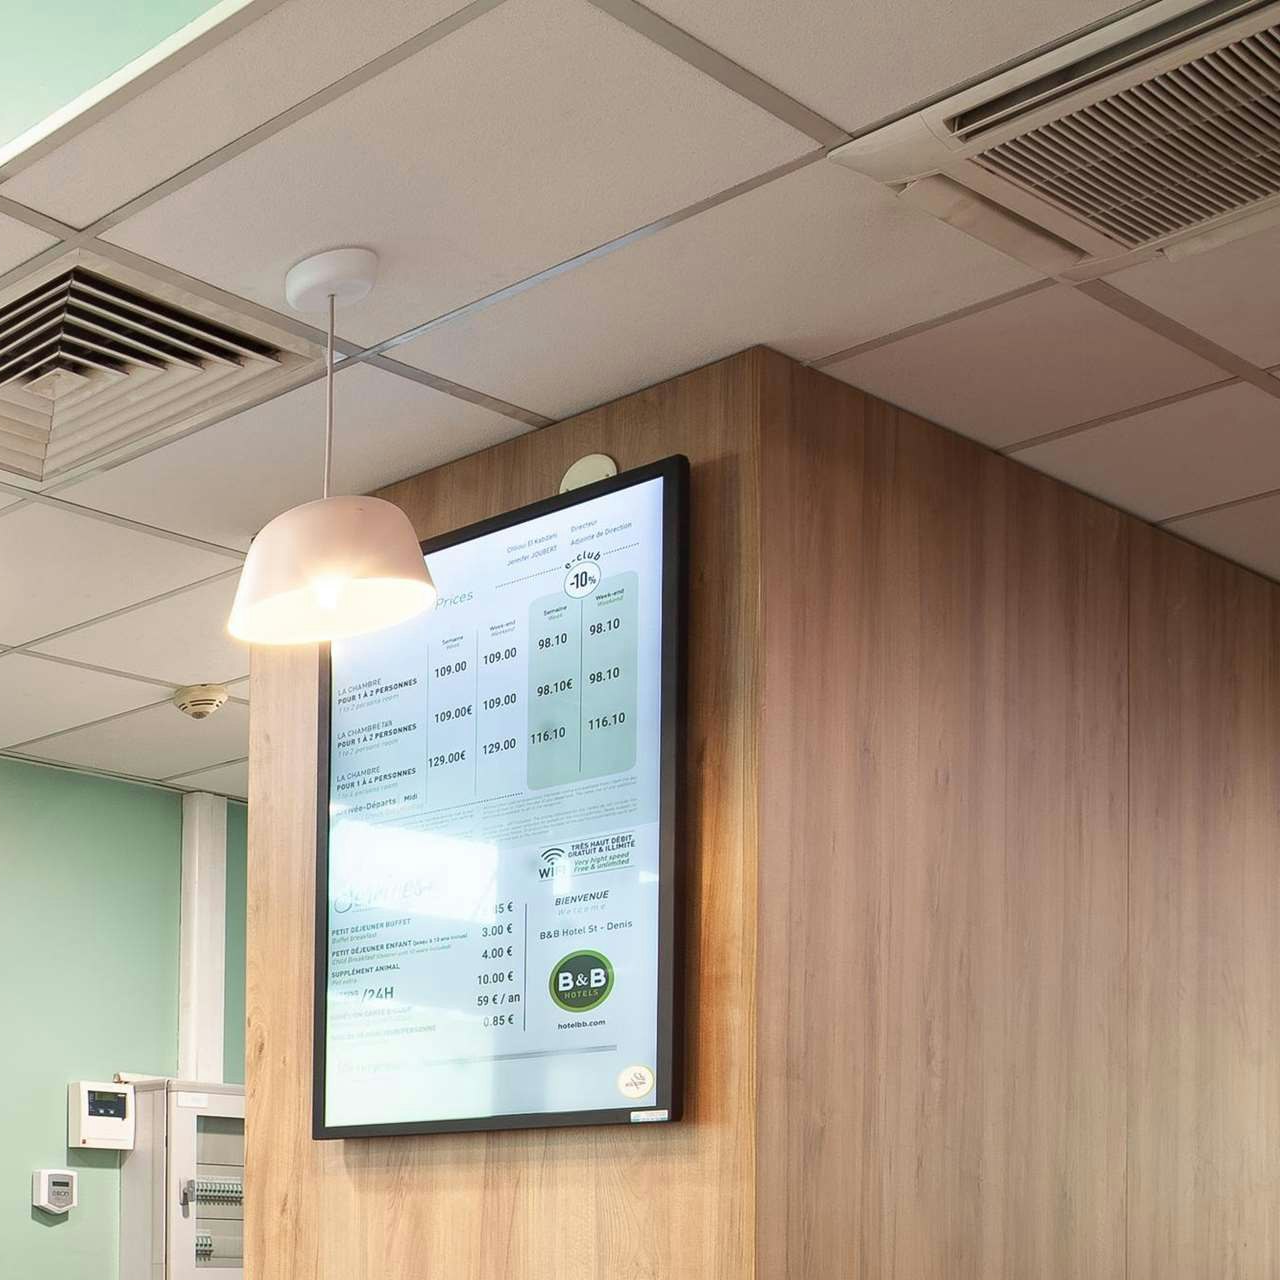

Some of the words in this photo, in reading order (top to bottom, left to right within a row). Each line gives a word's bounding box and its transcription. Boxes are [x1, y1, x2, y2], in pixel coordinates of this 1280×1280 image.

[565, 550, 601, 570] e-club
[589, 618, 620, 636] 98.10
[538, 633, 567, 650] 98.10
[483, 647, 517, 664] 109.00
[435, 661, 467, 678] 109.00
[589, 667, 620, 684] 98.10
[337, 694, 355, 704] POUR
[375, 677, 416, 695] PERSONNES
[537, 678, 573, 697] 98.10€
[483, 693, 517, 711] 109.00
[434, 704, 472, 723] 109.00€
[588, 712, 626, 731] 116.10
[337, 738, 354, 748] POUR
[375, 722, 416, 739] PERSONNES
[530, 727, 566, 744] 116.10
[483, 738, 517, 756] 129.00
[428, 750, 466, 768] 129.00€
[336, 781, 354, 791] POUR
[374, 766, 415, 783] PERSONNES
[590, 838, 609, 847] HAUT
[555, 889, 609, 906] BIENVENUE
[332, 927, 348, 936] PETIT
[482, 924, 504, 937] 3.00
[540, 929, 559, 939] B&B
[562, 925, 585, 936] Hotel
[588, 923, 597, 933] St
[607, 918, 632, 930] Denis
[332, 949, 348, 957] PETIT
[482, 947, 504, 959] 4.00
[331, 965, 372, 978] SUPPLÉMENT
[375, 962, 400, 972] ANIMAL
[478, 972, 505, 985] 10.00
[558, 968, 606, 991] B&B
[477, 995, 489, 1006] 59
[508, 993, 521, 1003] an
[564, 990, 599, 999] HOTELS
[483, 1015, 505, 1027] 0.85
[558, 1020, 606, 1030] hotelbb.com
